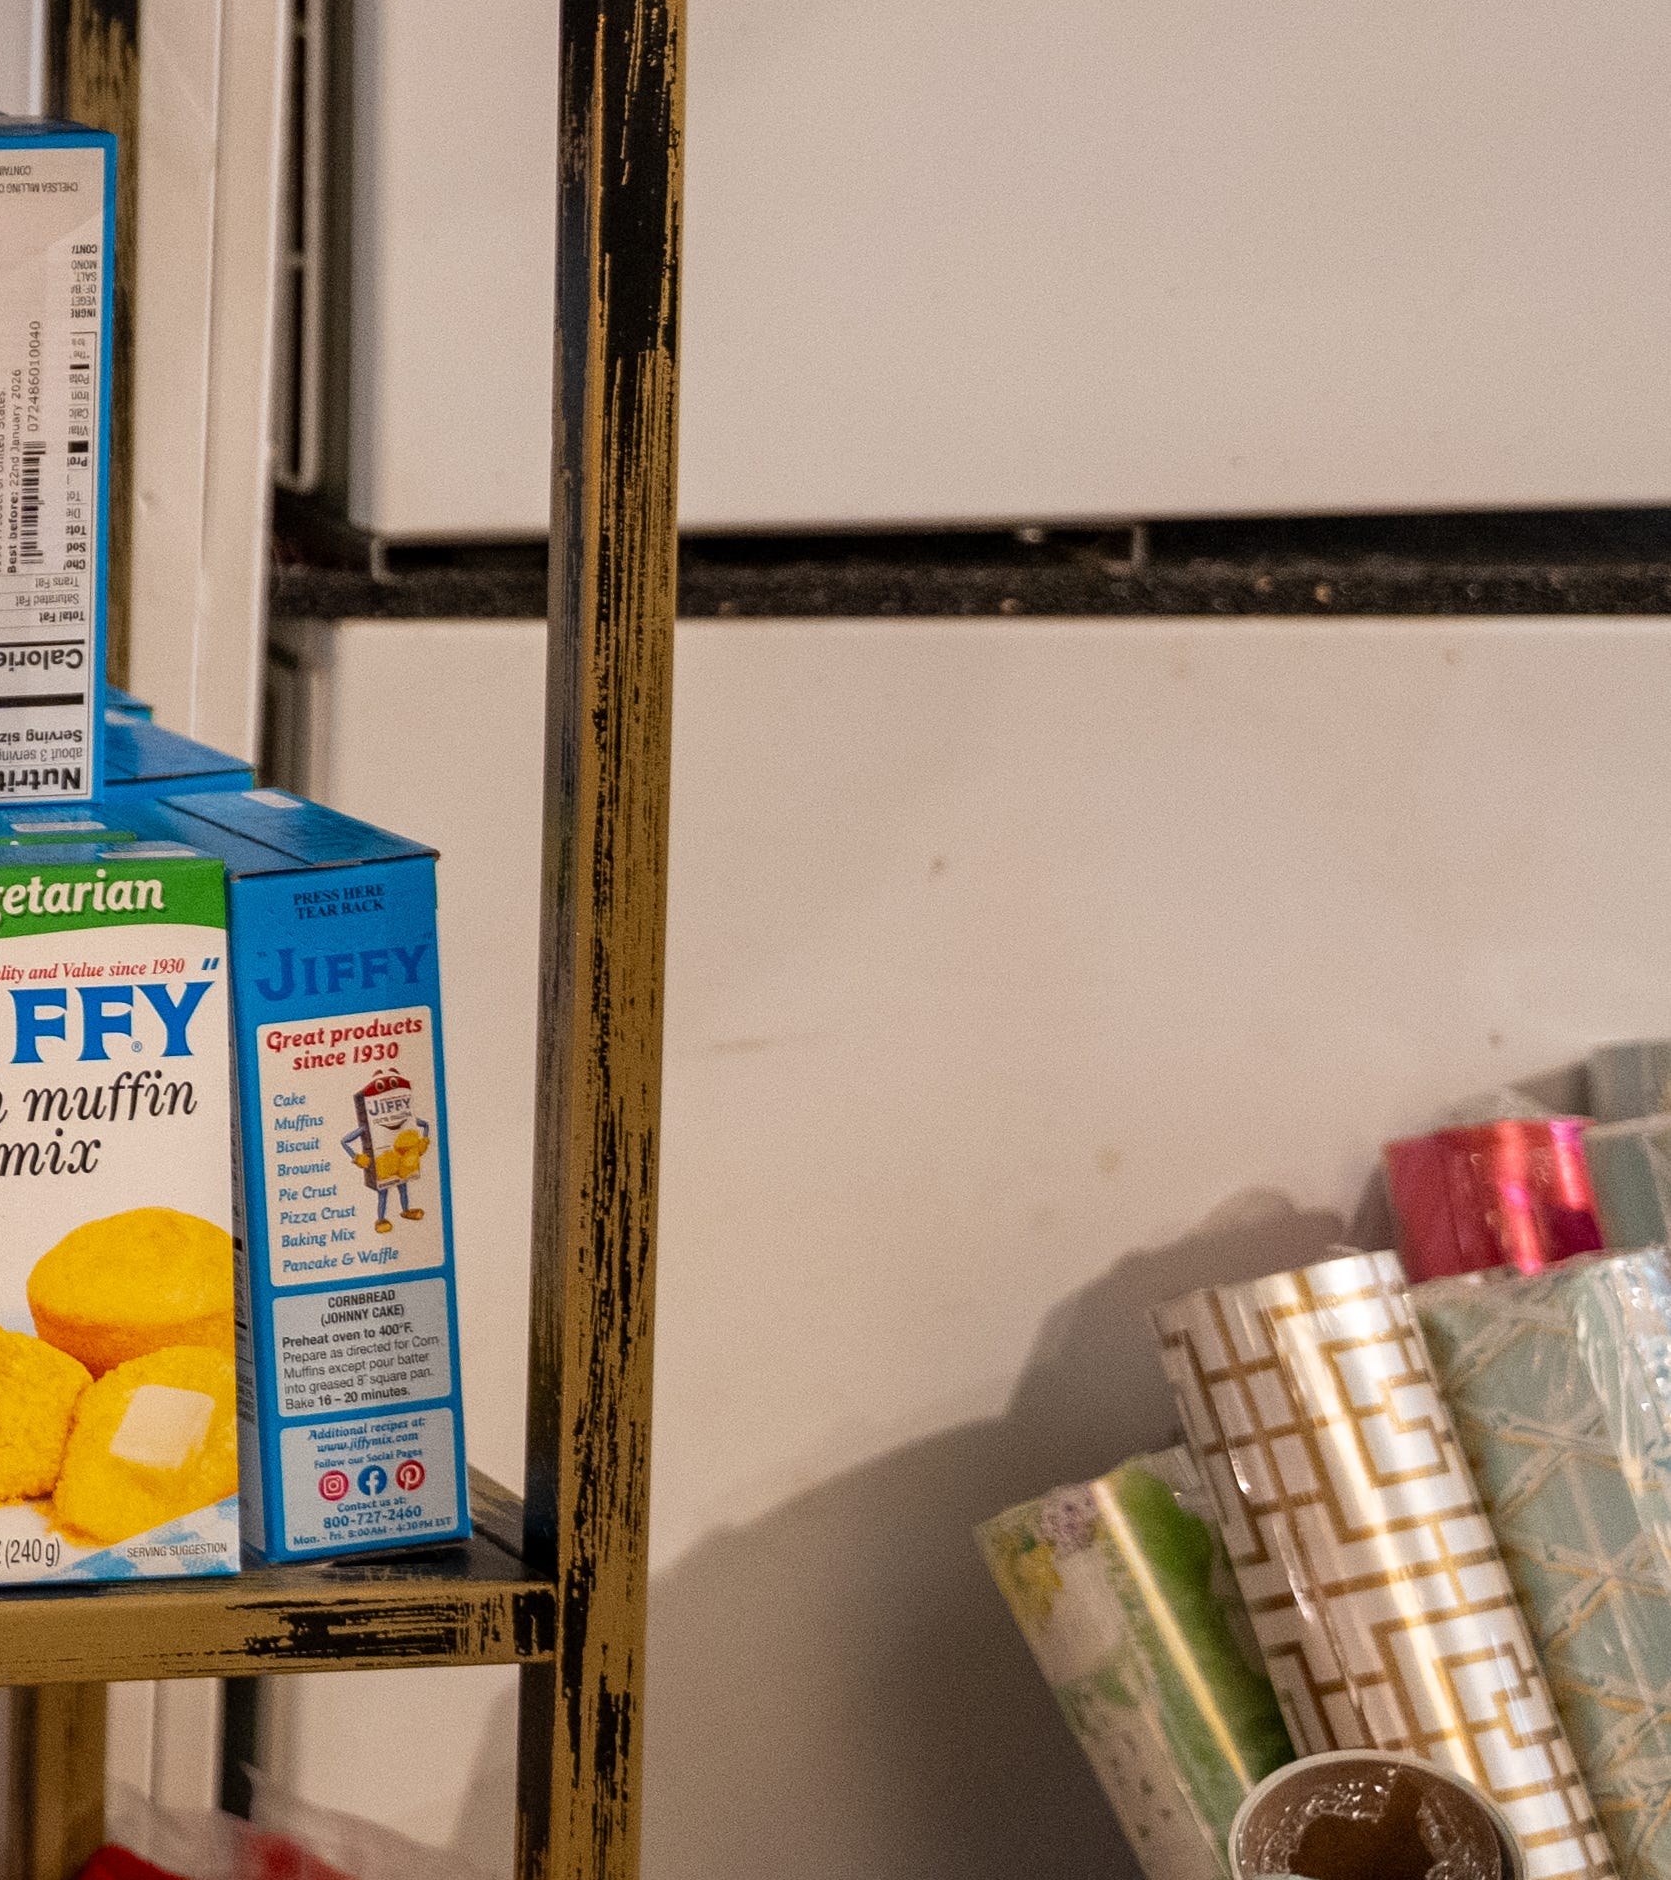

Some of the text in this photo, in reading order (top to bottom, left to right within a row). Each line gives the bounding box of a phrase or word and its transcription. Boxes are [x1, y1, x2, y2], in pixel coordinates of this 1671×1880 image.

[28, 321, 41, 432] 072486010040
[8, 369, 22, 573] Best before: 22nd January 2026
[28, 962, 58, 980] and
[63, 962, 103, 979] Value
[108, 960, 146, 976] since
[152, 958, 185, 975] 1930
[266, 1017, 423, 1052] Great products
[293, 1042, 399, 1070] since 1930
[23, 1070, 197, 1122] muffin
